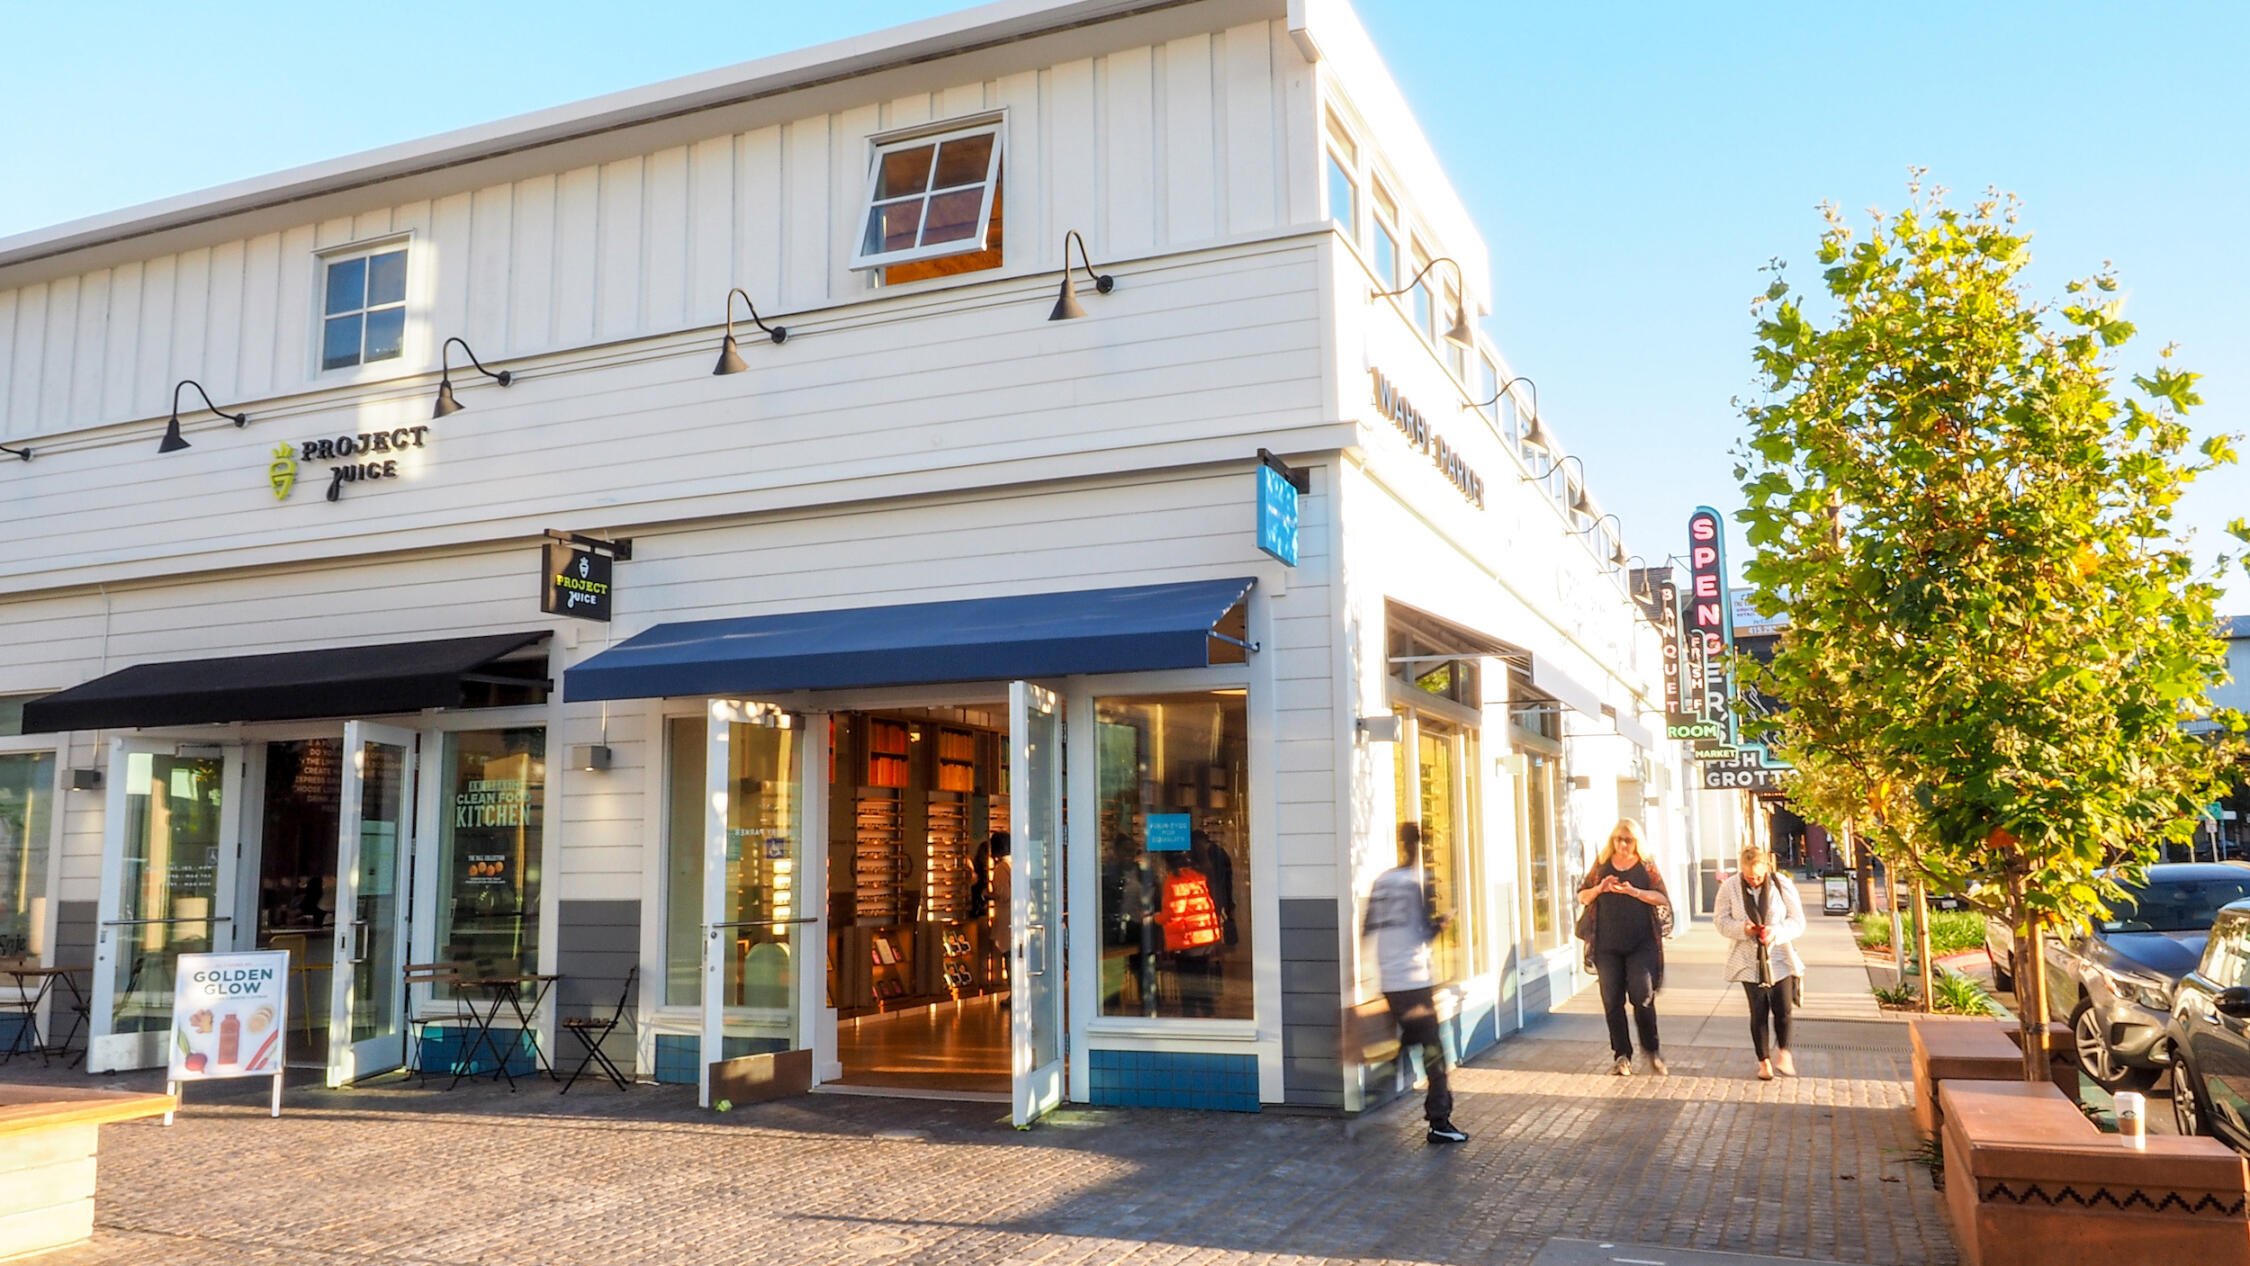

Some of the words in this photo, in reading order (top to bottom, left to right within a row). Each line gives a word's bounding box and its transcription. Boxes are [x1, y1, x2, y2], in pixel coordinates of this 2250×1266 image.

[300, 425, 428, 462] PROJECT
[326, 459, 398, 502] JUICE
[555, 574, 608, 595] PROJECT
[567, 590, 597, 609] JUICE
[1661, 588, 1679, 714] BANQUET
[1690, 637, 1703, 689] FRSH
[1667, 725, 1717, 738] ROOM
[1695, 750, 1736, 758] MARKET
[1706, 753, 1757, 768] FISH
[456, 793, 496, 805] CLEAN
[498, 790, 532, 803] FOOD
[456, 804, 532, 828] KITCHEN
[193, 968, 273, 983] GOLDEN
[204, 982, 262, 995] GLOW
